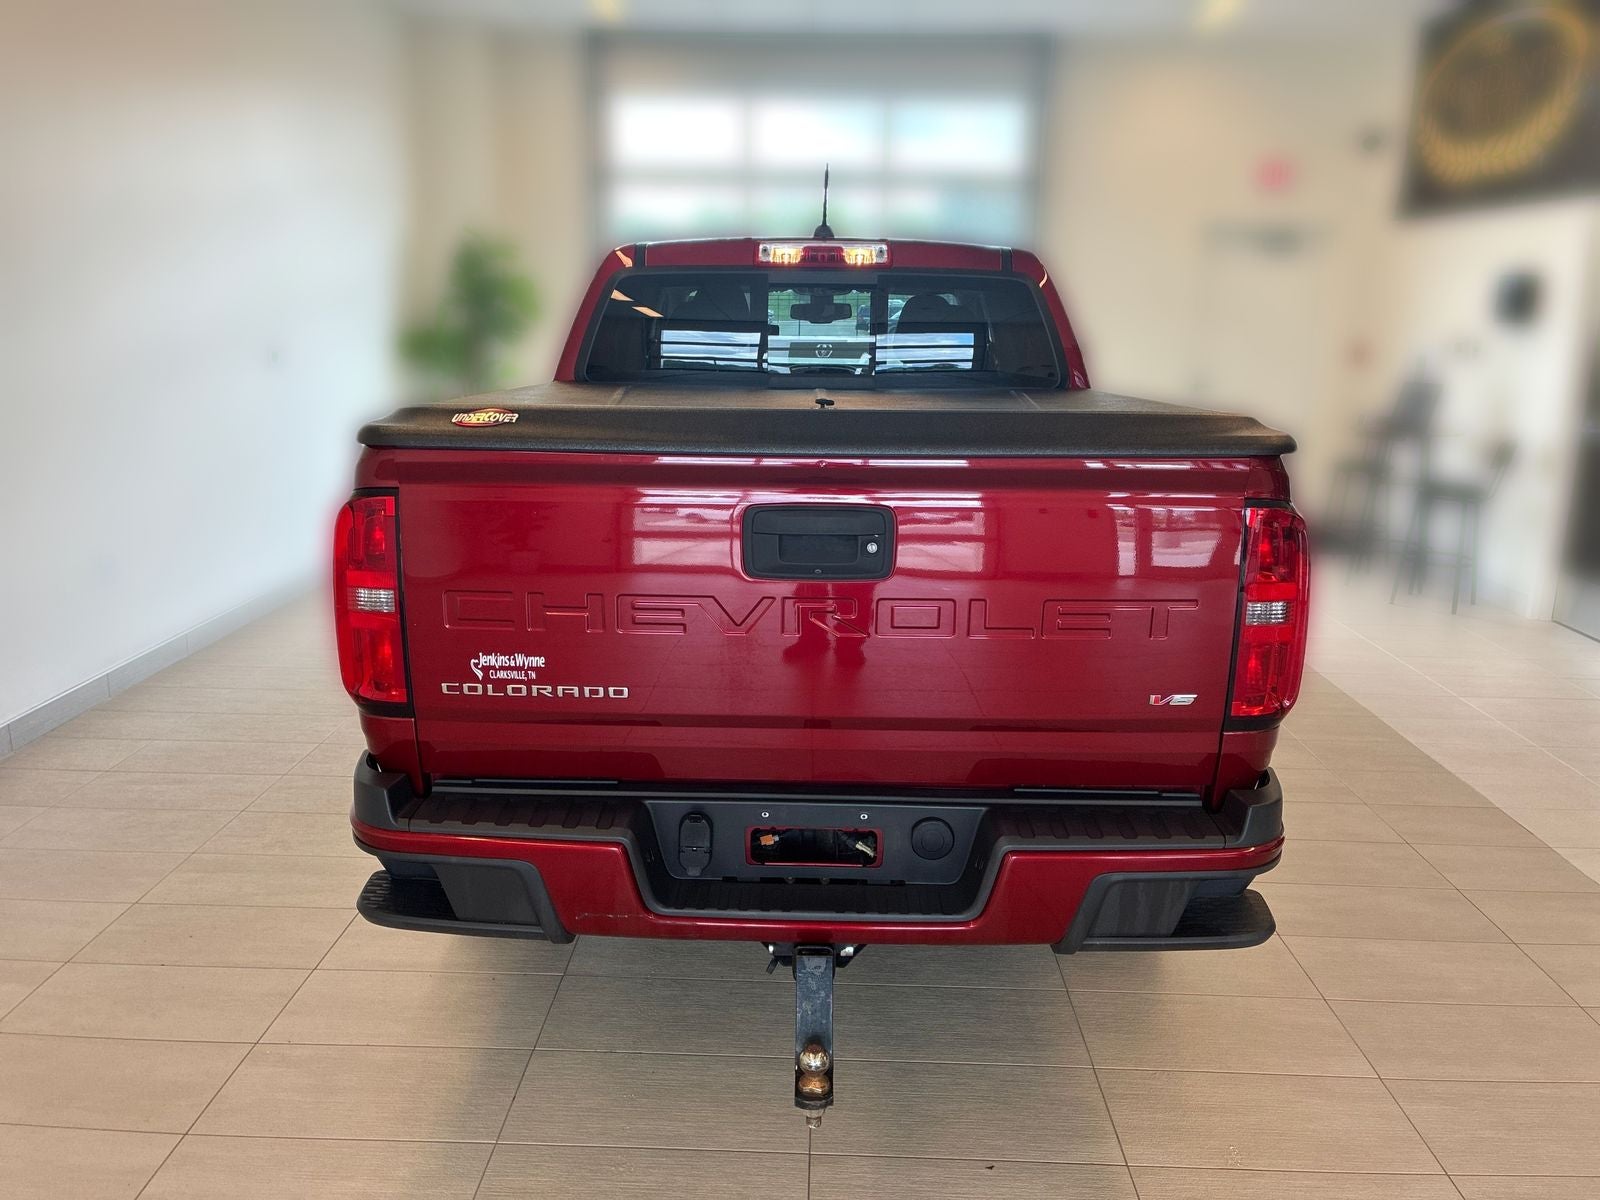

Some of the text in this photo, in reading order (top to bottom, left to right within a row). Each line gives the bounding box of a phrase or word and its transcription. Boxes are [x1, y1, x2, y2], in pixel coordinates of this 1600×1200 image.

[442, 590, 1199, 640] CHEVROLET
[489, 670, 536, 681] CLARKSVILLE, TN
[441, 682, 629, 698] COLORADO
[1149, 694, 1198, 706] V6
